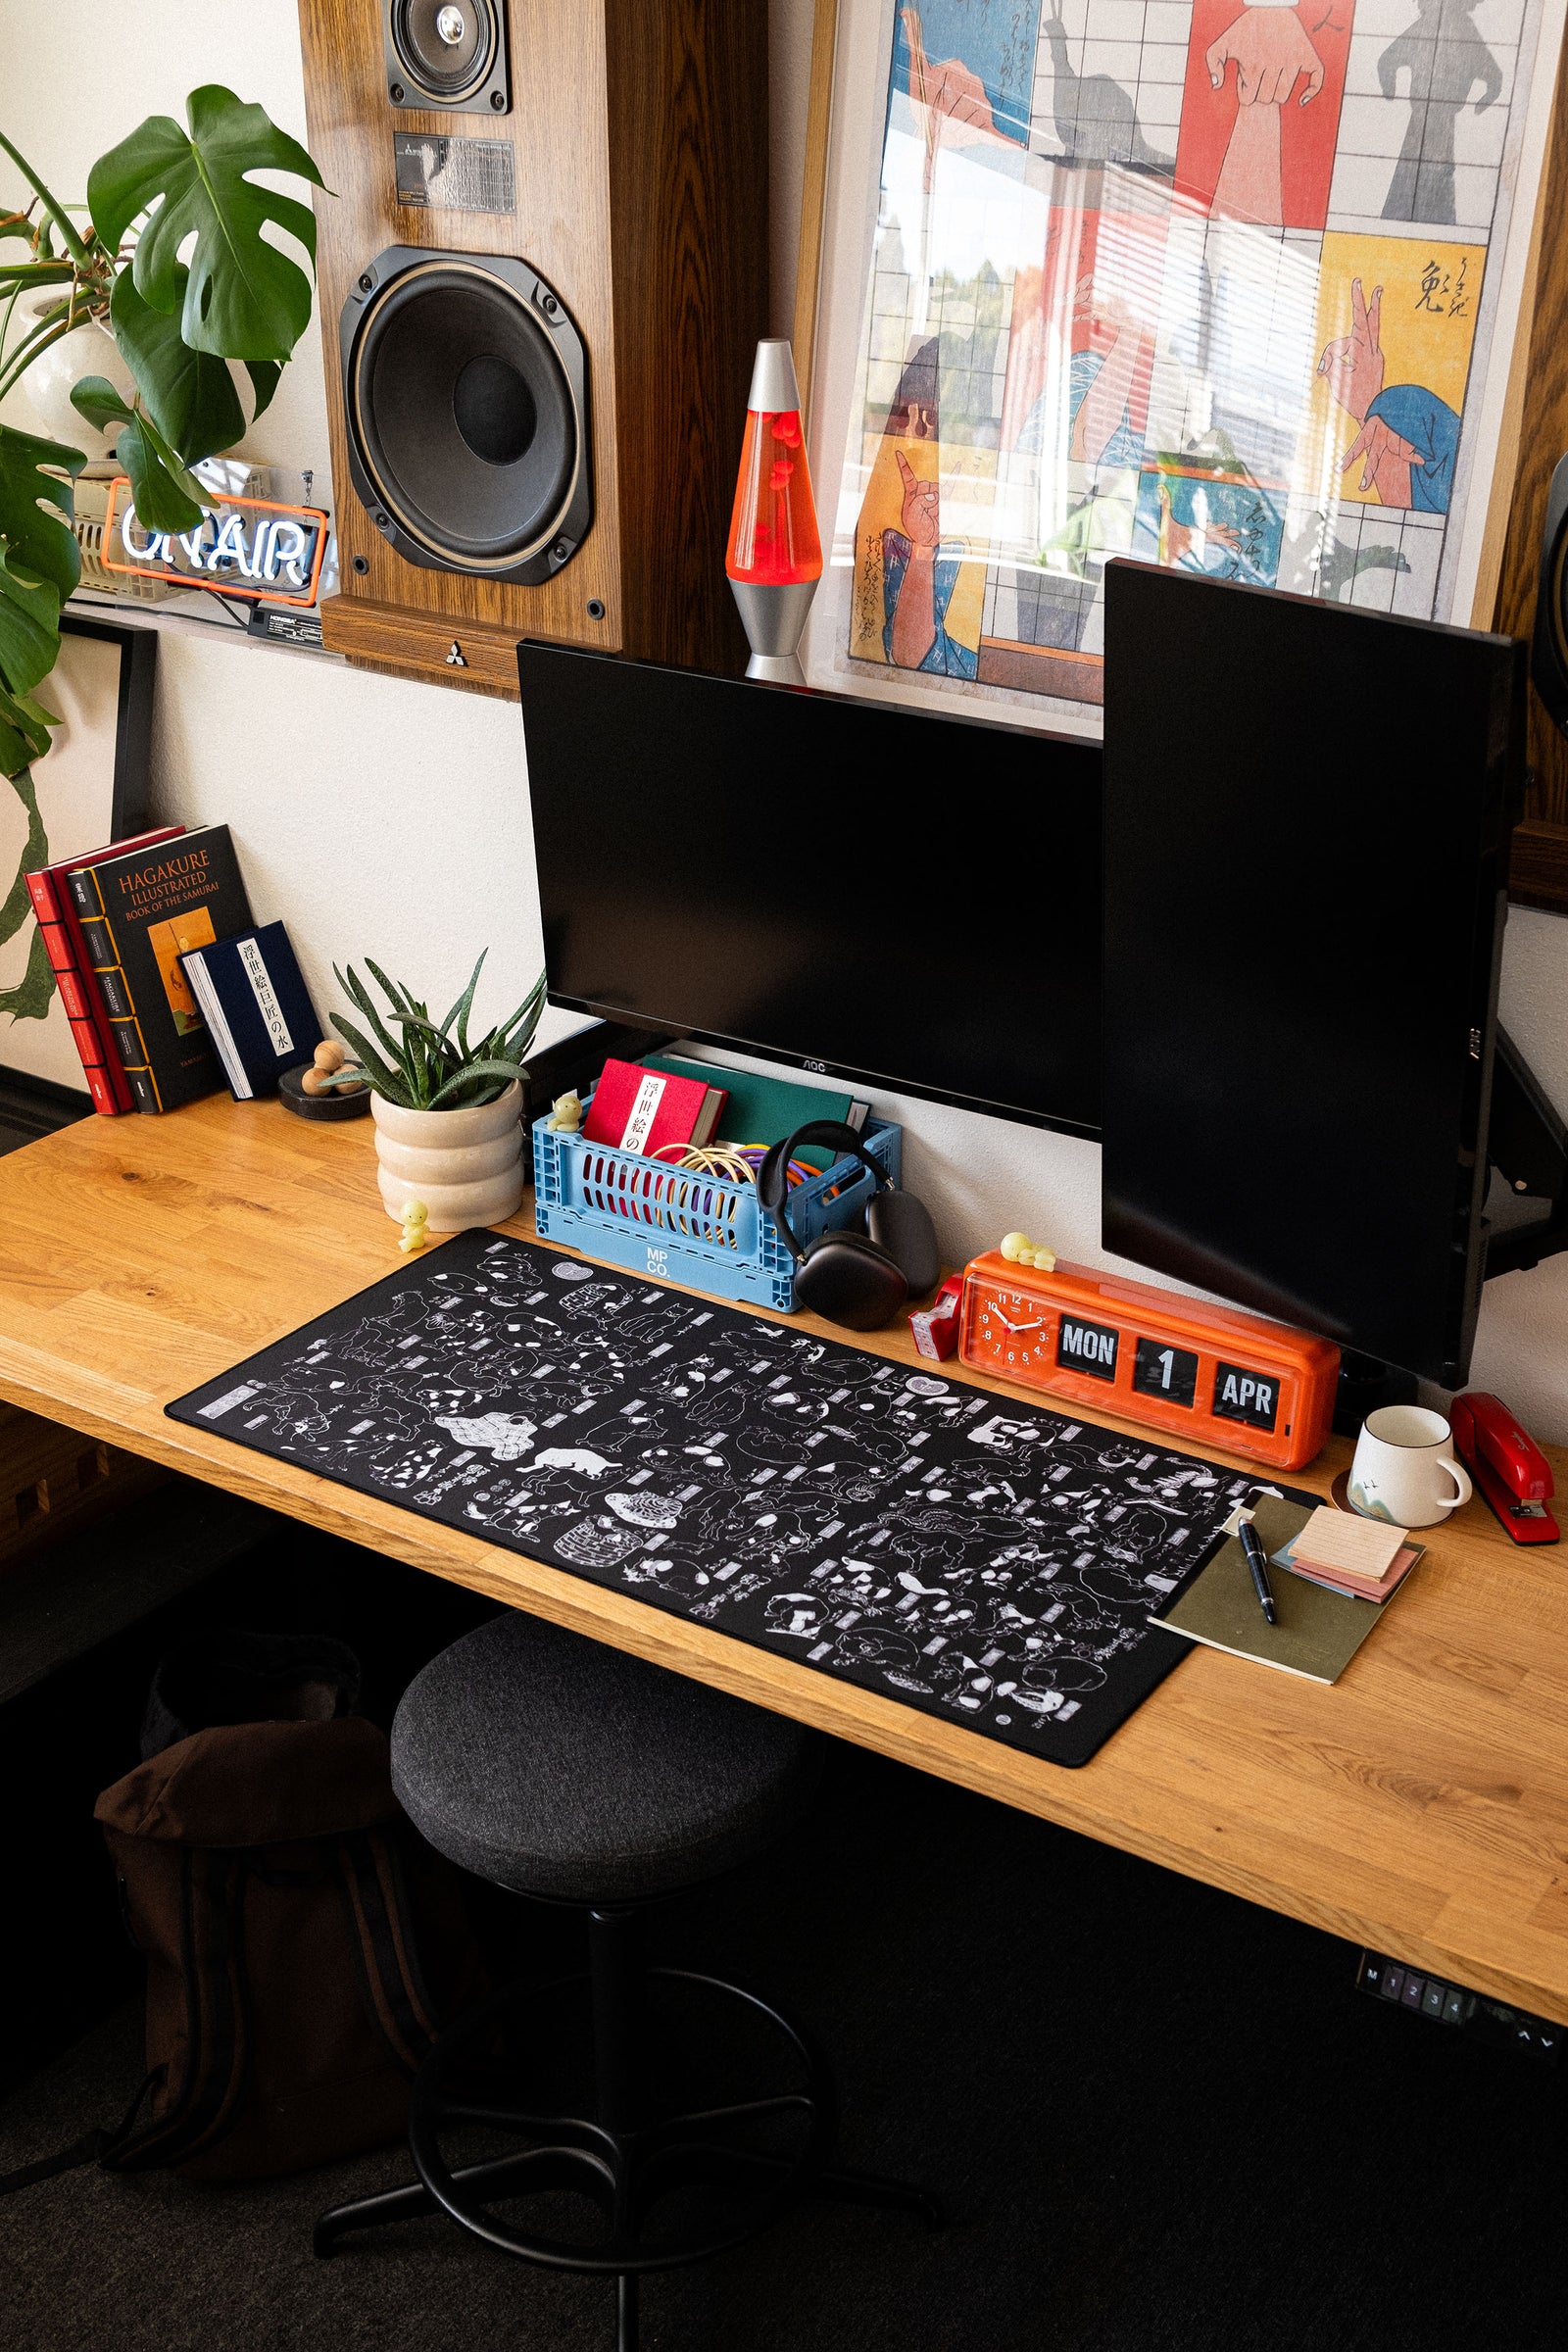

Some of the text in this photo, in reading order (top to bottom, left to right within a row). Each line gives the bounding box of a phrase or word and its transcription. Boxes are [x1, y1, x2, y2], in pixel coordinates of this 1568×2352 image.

[207, 514, 307, 586] AIR
[119, 850, 210, 894] HAGAKURE
[131, 871, 207, 906] ILLUSTRATED
[125, 881, 220, 922] BOOK OF THE SAMURAI
[647, 1247, 668, 1263] MP
[647, 1260, 671, 1278] CO.
[998, 1293, 1006, 1304] 11
[1011, 1294, 1022, 1304] 12
[987, 1300, 998, 1312] 10
[1028, 1302, 1032, 1312] 1
[982, 1314, 989, 1324] 9
[1036, 1316, 1043, 1326] 2
[985, 1330, 992, 1341] 8
[1039, 1332, 1046, 1342] 3
[995, 1343, 1002, 1353] 7
[1062, 1324, 1115, 1365] MON
[1007, 1351, 1014, 1361] 6
[1034, 1346, 1040, 1355] 4
[1022, 1351, 1029, 1362] 5
[1157, 1349, 1174, 1390] 1
[1221, 1374, 1272, 1415] APR
[1366, 1968, 1378, 1981] M
[1390, 1979, 1396, 1987] 1
[1409, 1985, 1418, 1996] 2
[1431, 1994, 1439, 2005] 3
[1450, 2003, 1458, 2013] 4
